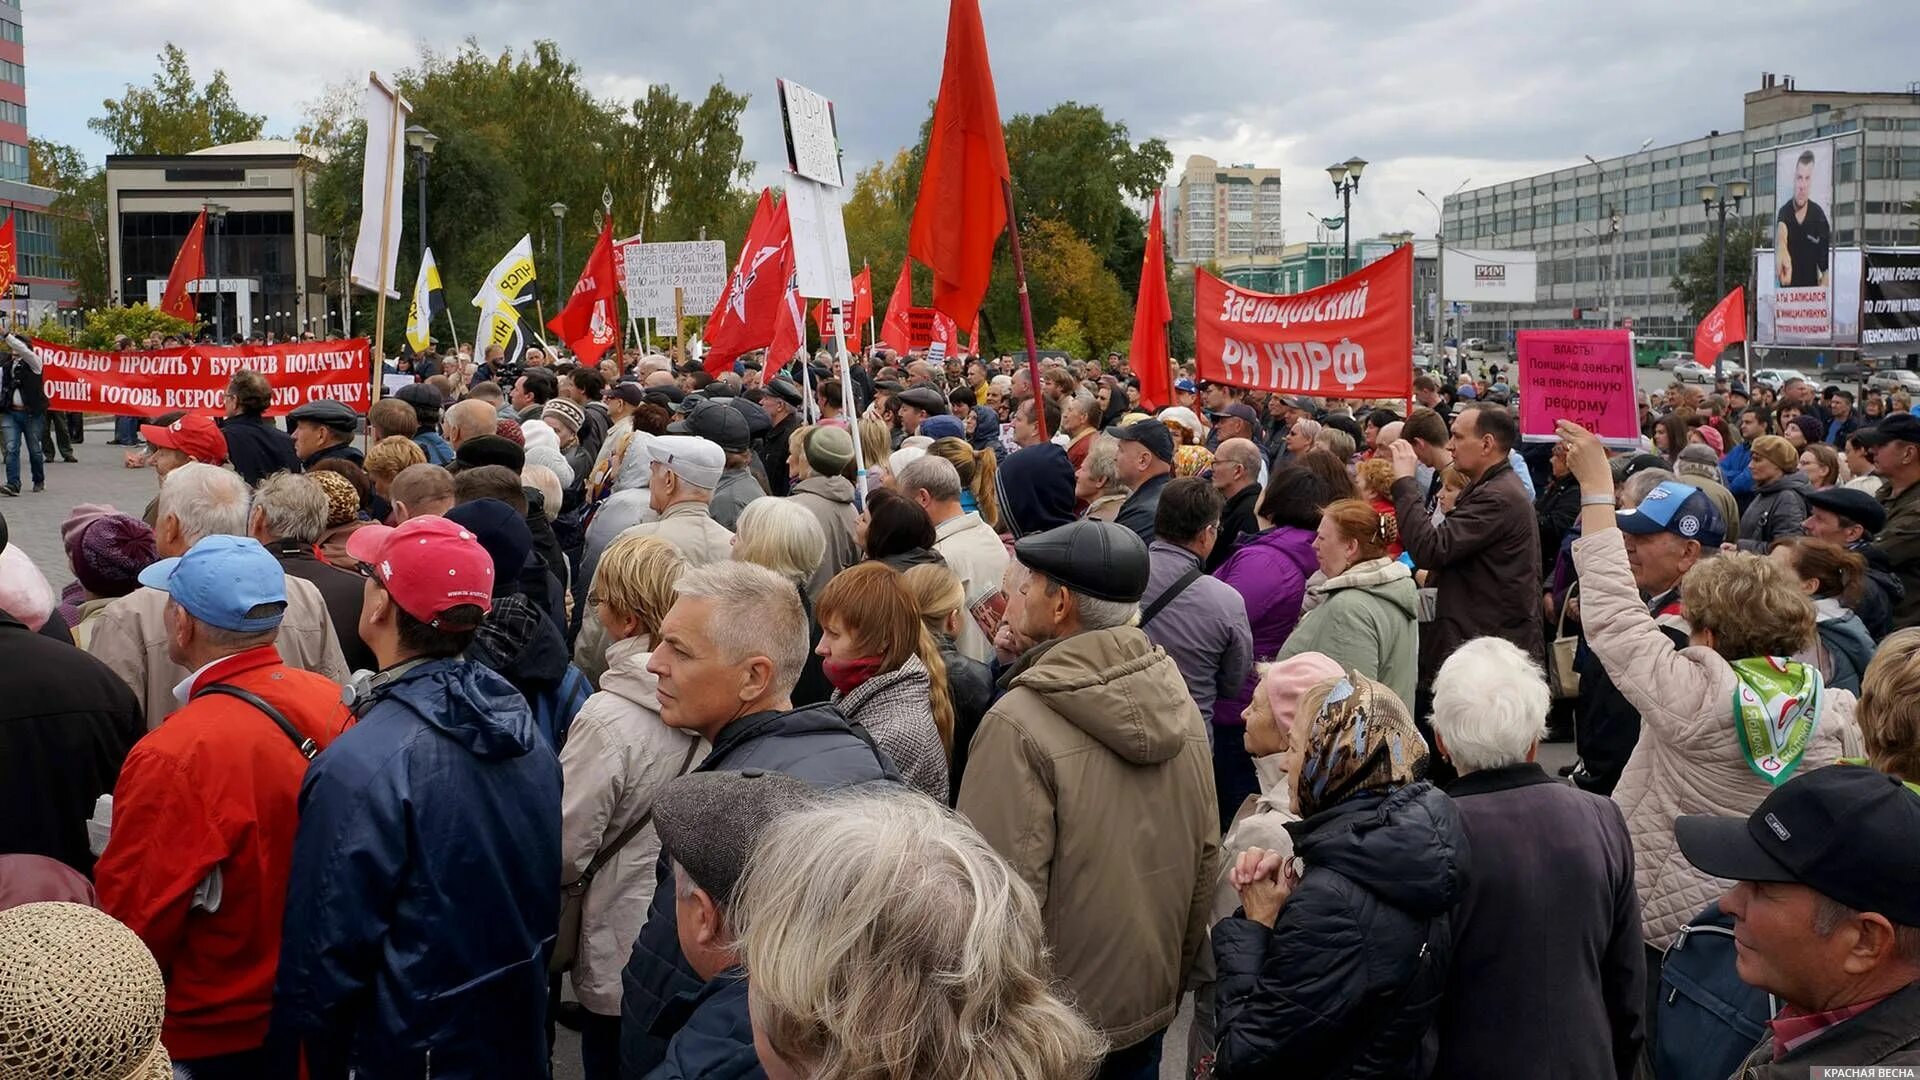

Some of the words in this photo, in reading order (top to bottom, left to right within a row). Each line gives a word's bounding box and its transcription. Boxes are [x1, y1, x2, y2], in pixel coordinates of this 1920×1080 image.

[1476, 266, 1504, 276] РИМ
[1220, 280, 1369, 328] Заельцовский
[1553, 344, 1594, 356] ВЛАСТЬ!
[33, 346, 112, 373] ОВОЛЬНО
[119, 356, 188, 375] ПРОСИТЬ
[191, 356, 201, 375] У
[210, 355, 278, 376] БУРЖУЕВ
[1222, 337, 1260, 387] РК
[1264, 338, 1368, 391] КПРФ
[1582, 363, 1624, 375] деньги
[43, 378, 91, 401] ОЧИЙ!
[100, 384, 162, 407] ГОТОВЬ
[1533, 377, 1546, 387] на
[1549, 378, 1622, 394] пенсионную
[1545, 397, 1608, 416] реформу
